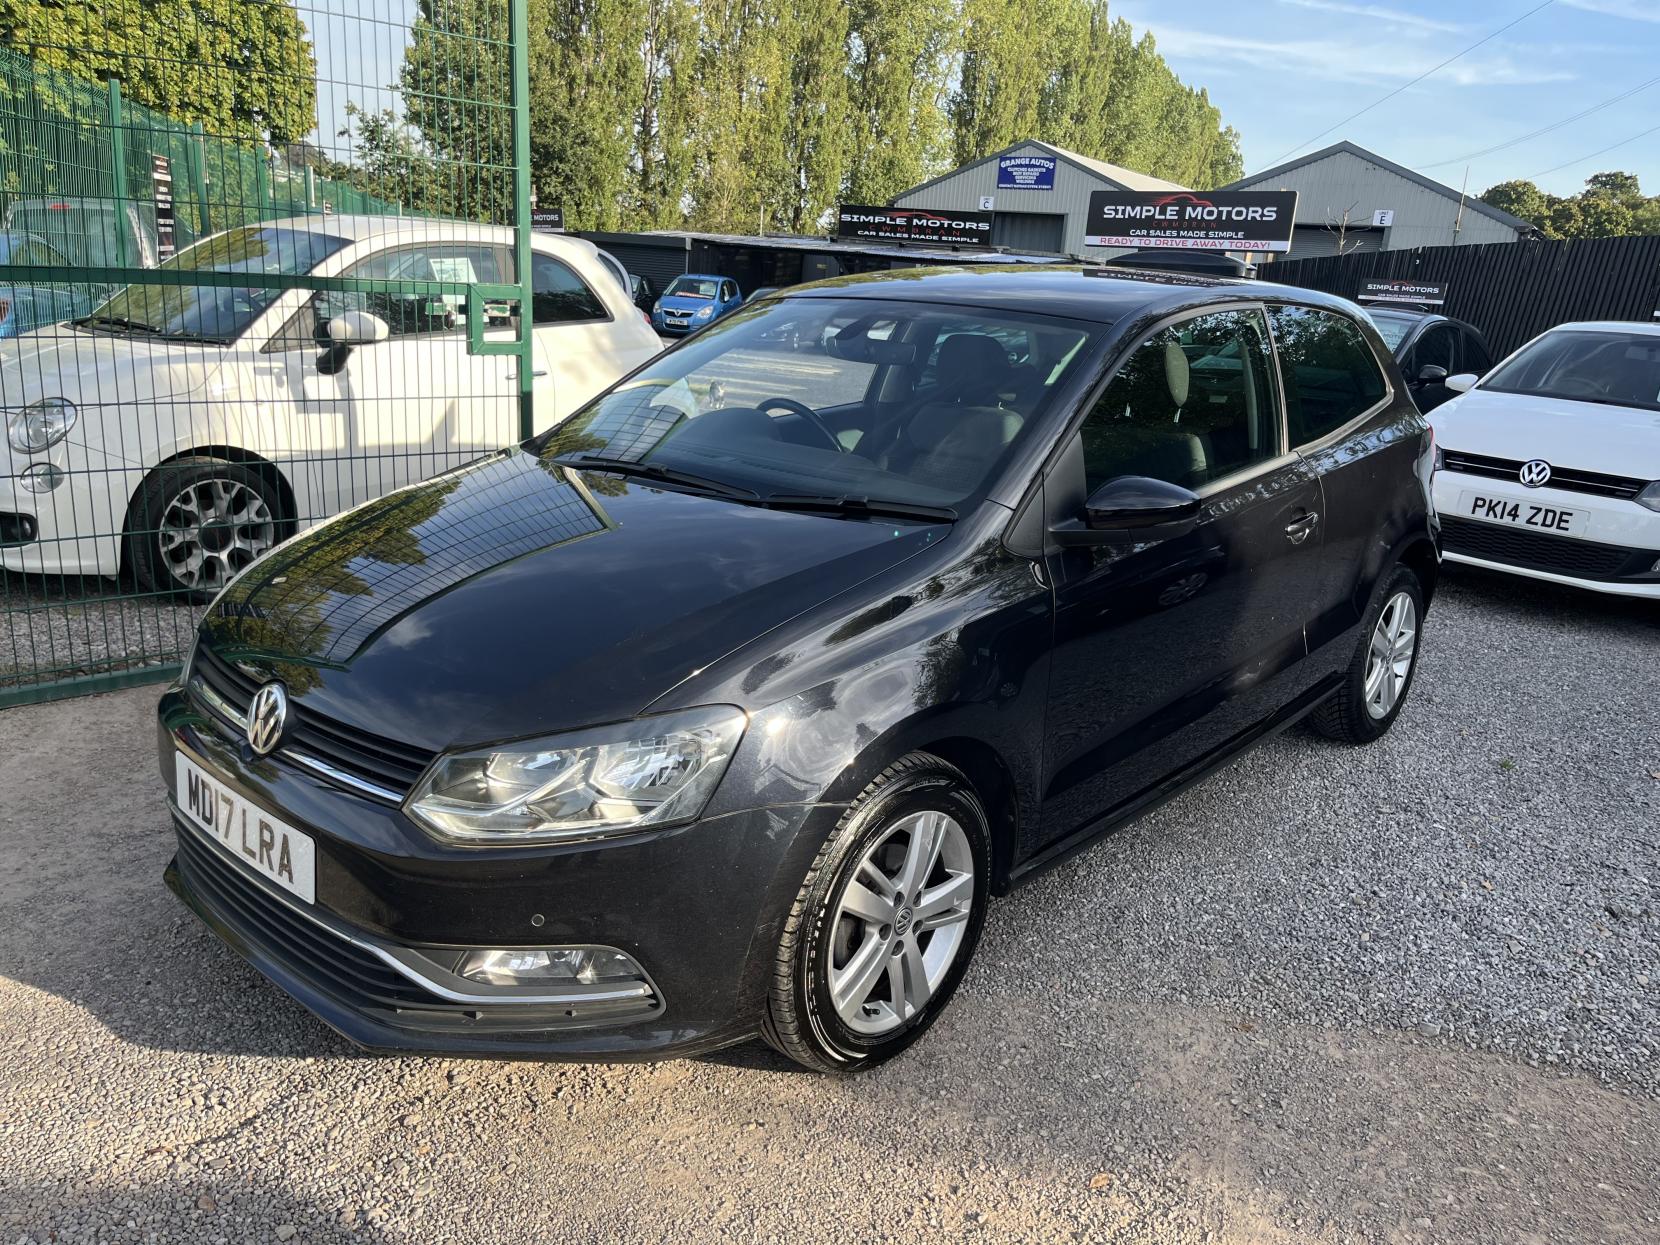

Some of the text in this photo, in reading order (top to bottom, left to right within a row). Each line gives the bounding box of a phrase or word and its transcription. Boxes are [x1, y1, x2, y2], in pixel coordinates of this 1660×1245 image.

[1001, 158, 1055, 169] GRANGE AUTOS
[983, 201, 989, 209] C
[1103, 205, 1277, 221] SIMPLE MOTORS
[840, 213, 990, 231] SIMPLE MOTORS
[1379, 215, 1386, 225] E
[869, 224, 960, 236] CWMBRAN
[1179, 230, 1207, 238] MADE
[1208, 231, 1244, 239] SIMPLE
[911, 233, 939, 241] MADE
[1100, 237, 1271, 249] READY TO DRIVE AWAY TODAY!
[1367, 284, 1439, 294] SIMPLE MOTORS
[1471, 496, 1573, 531] PK14 ZDE
[188, 768, 294, 884] MD17 LRA
